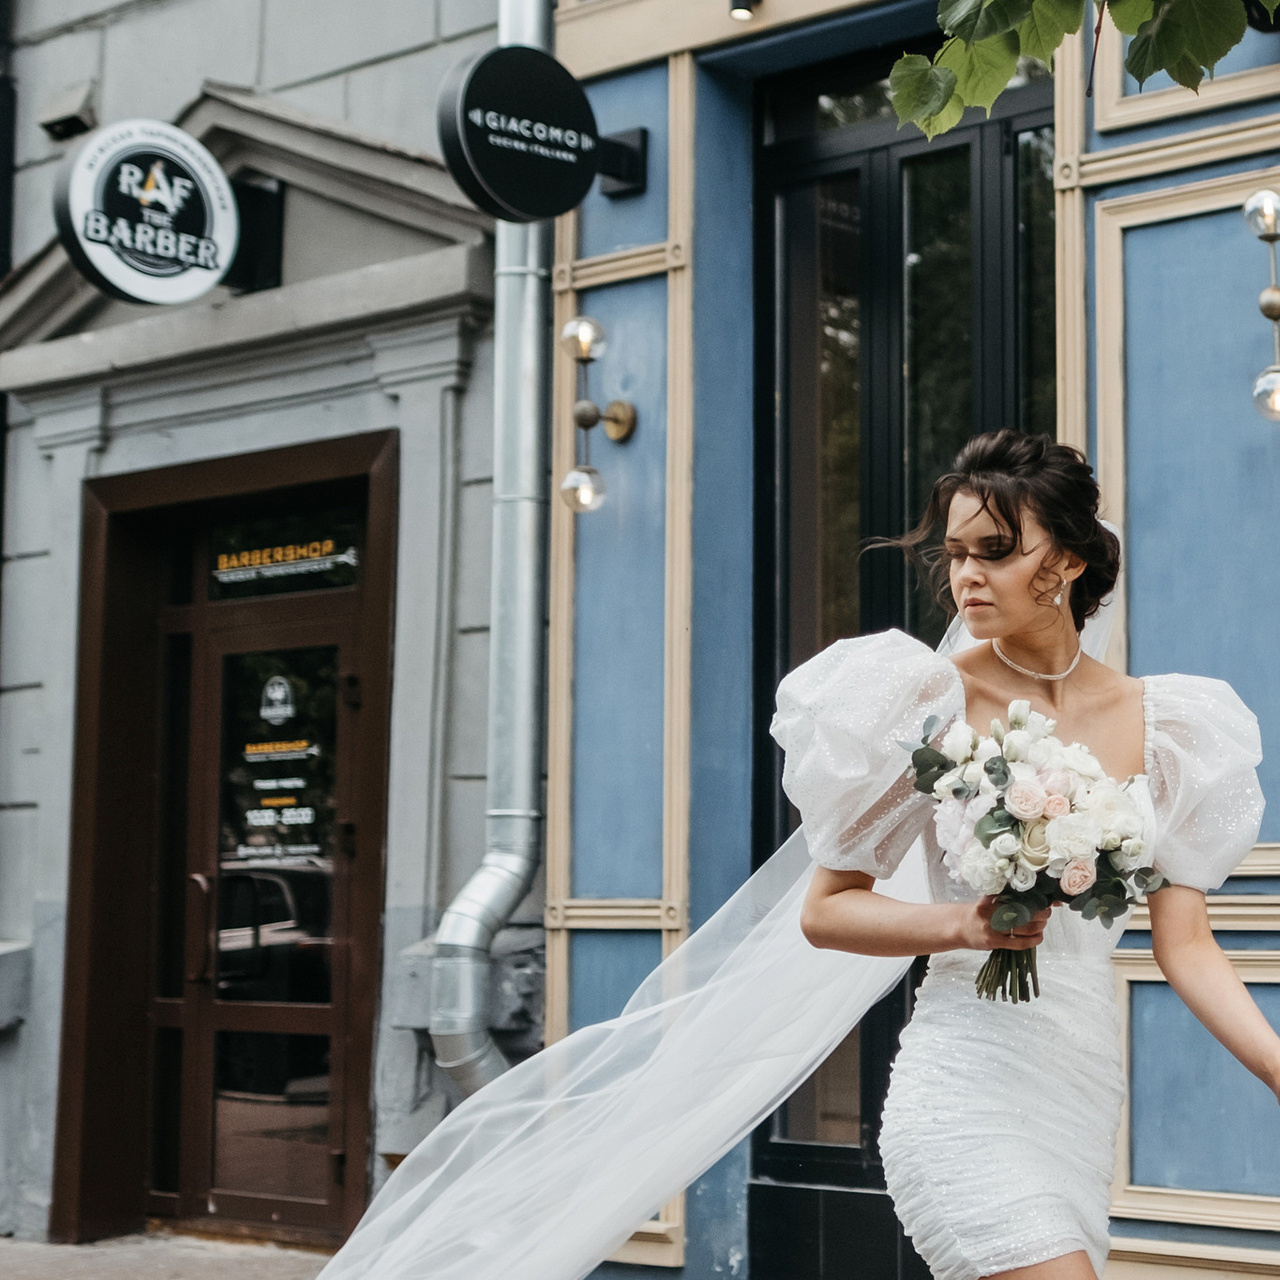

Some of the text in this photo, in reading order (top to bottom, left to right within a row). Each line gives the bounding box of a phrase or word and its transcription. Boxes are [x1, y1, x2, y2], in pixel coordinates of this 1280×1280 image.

[485, 110, 580, 149] GIACOMO
[117, 160, 194, 216] RAF
[85, 210, 219, 270] BARBER
[217, 539, 335, 570] BARBERSHOP
